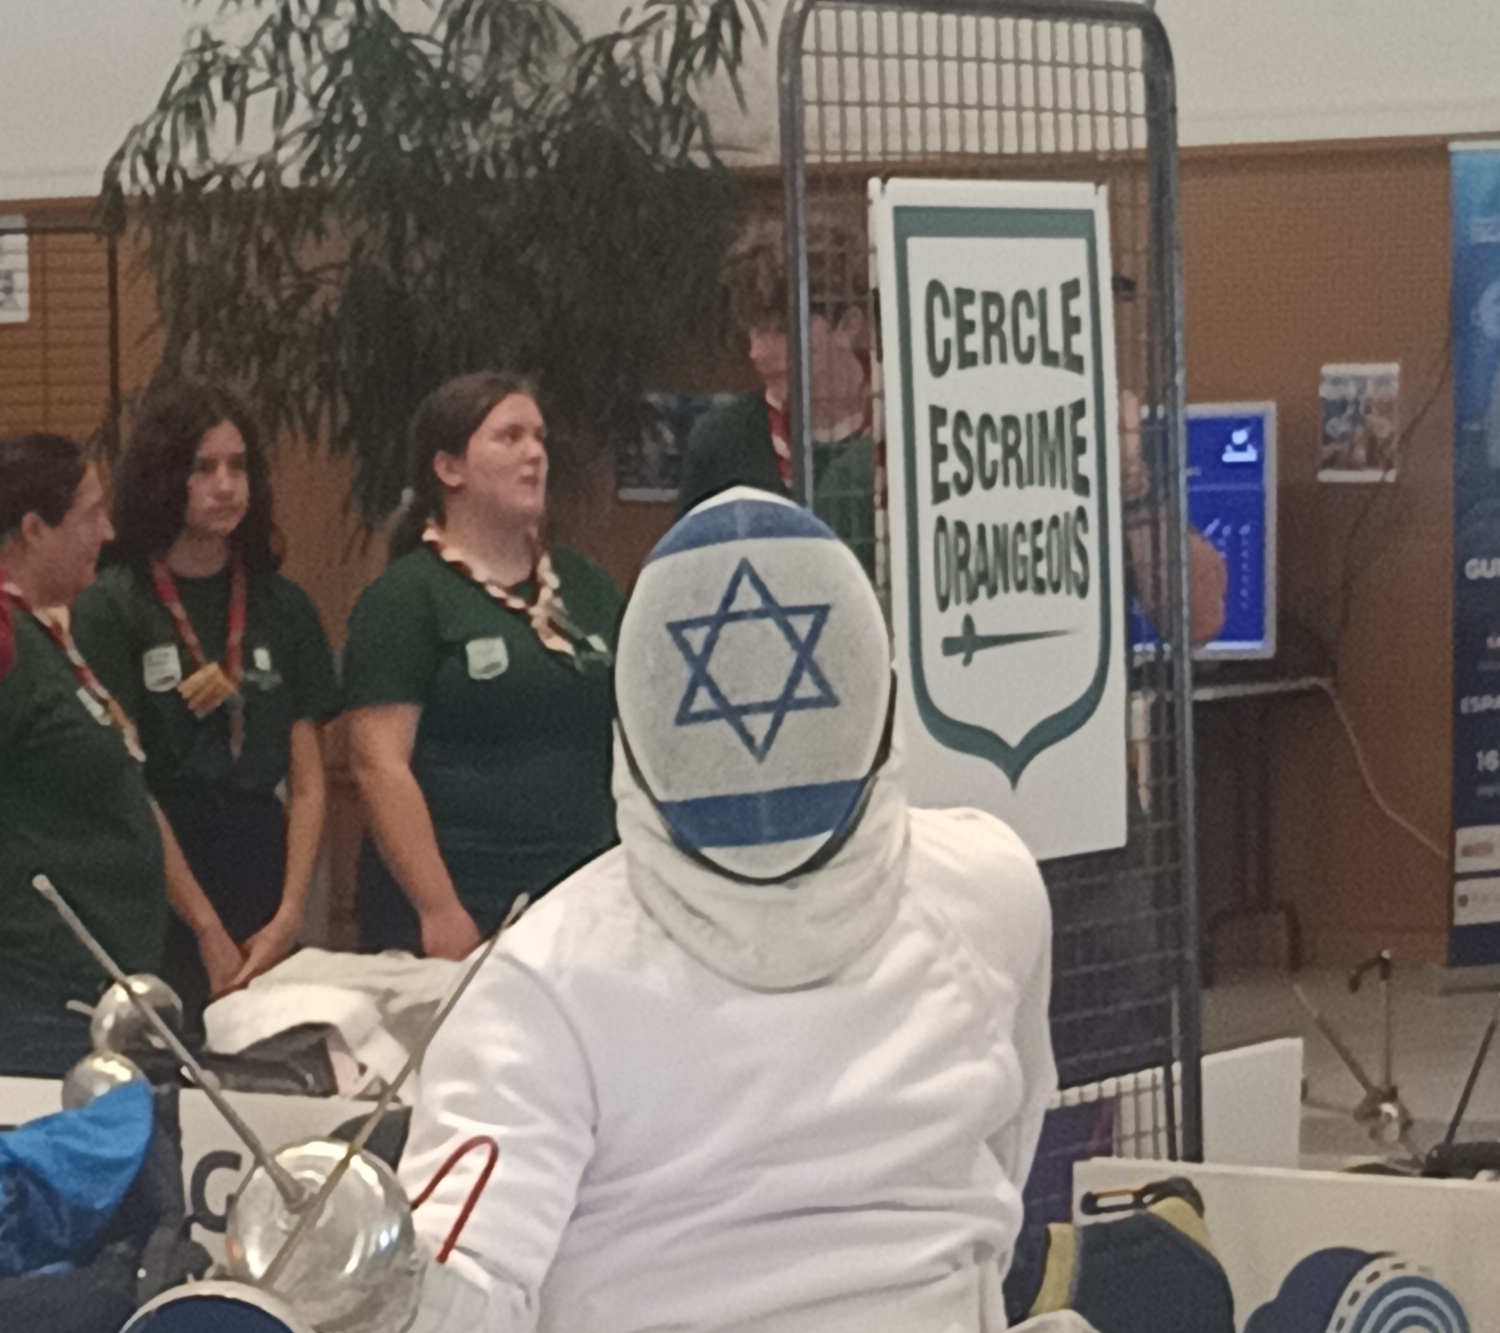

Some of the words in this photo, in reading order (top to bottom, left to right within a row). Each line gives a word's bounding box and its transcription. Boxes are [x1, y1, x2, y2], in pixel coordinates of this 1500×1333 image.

[925, 278, 1085, 378] CERCLE
[928, 397, 1090, 506] ESCRIME
[934, 505, 1090, 613] ORANGEOIS
